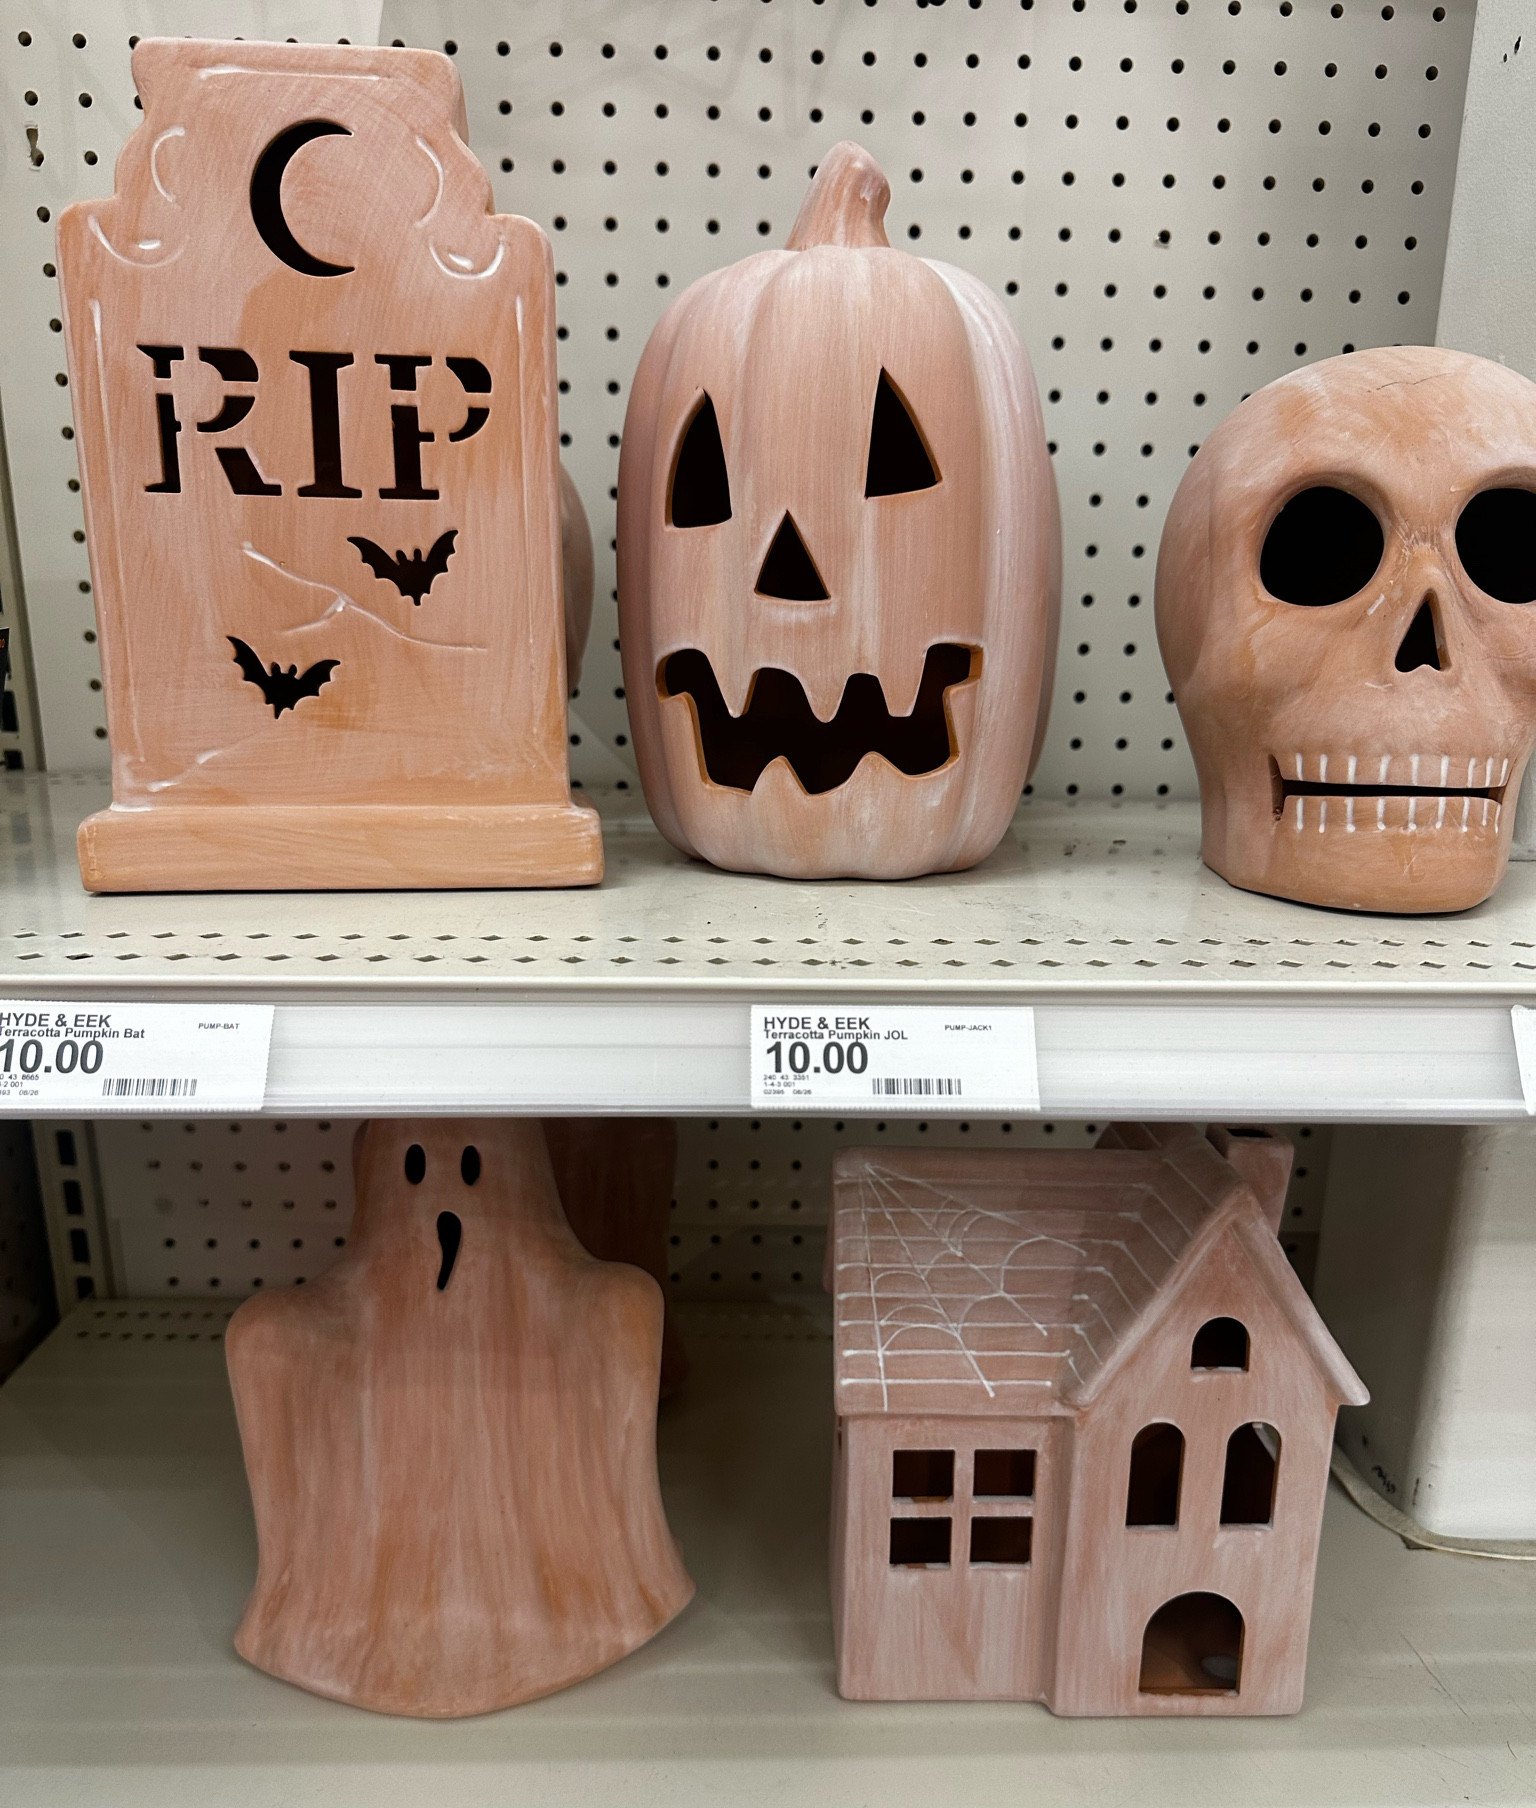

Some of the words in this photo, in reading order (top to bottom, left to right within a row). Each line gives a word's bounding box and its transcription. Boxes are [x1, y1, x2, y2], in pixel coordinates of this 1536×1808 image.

[136, 344, 492, 500] RIP
[0, 1012, 50, 1027] HYDE
[55, 1013, 67, 1027] &
[73, 1014, 112, 1028] EEK
[198, 1022, 240, 1030] PUMP-BAT
[764, 1016, 812, 1030] HYDE
[817, 1016, 829, 1030] &
[835, 1017, 870, 1030] EEK
[0, 1026, 61, 1037] Terracotta
[65, 1027, 119, 1041] Pumpkin
[123, 1028, 146, 1039] Bat
[764, 1028, 825, 1039] Terracotta
[828, 1029, 881, 1042] Pumpkin
[884, 1030, 909, 1040] JOL
[0, 1038, 104, 1074] 10.00
[766, 1041, 869, 1074] 10.00
